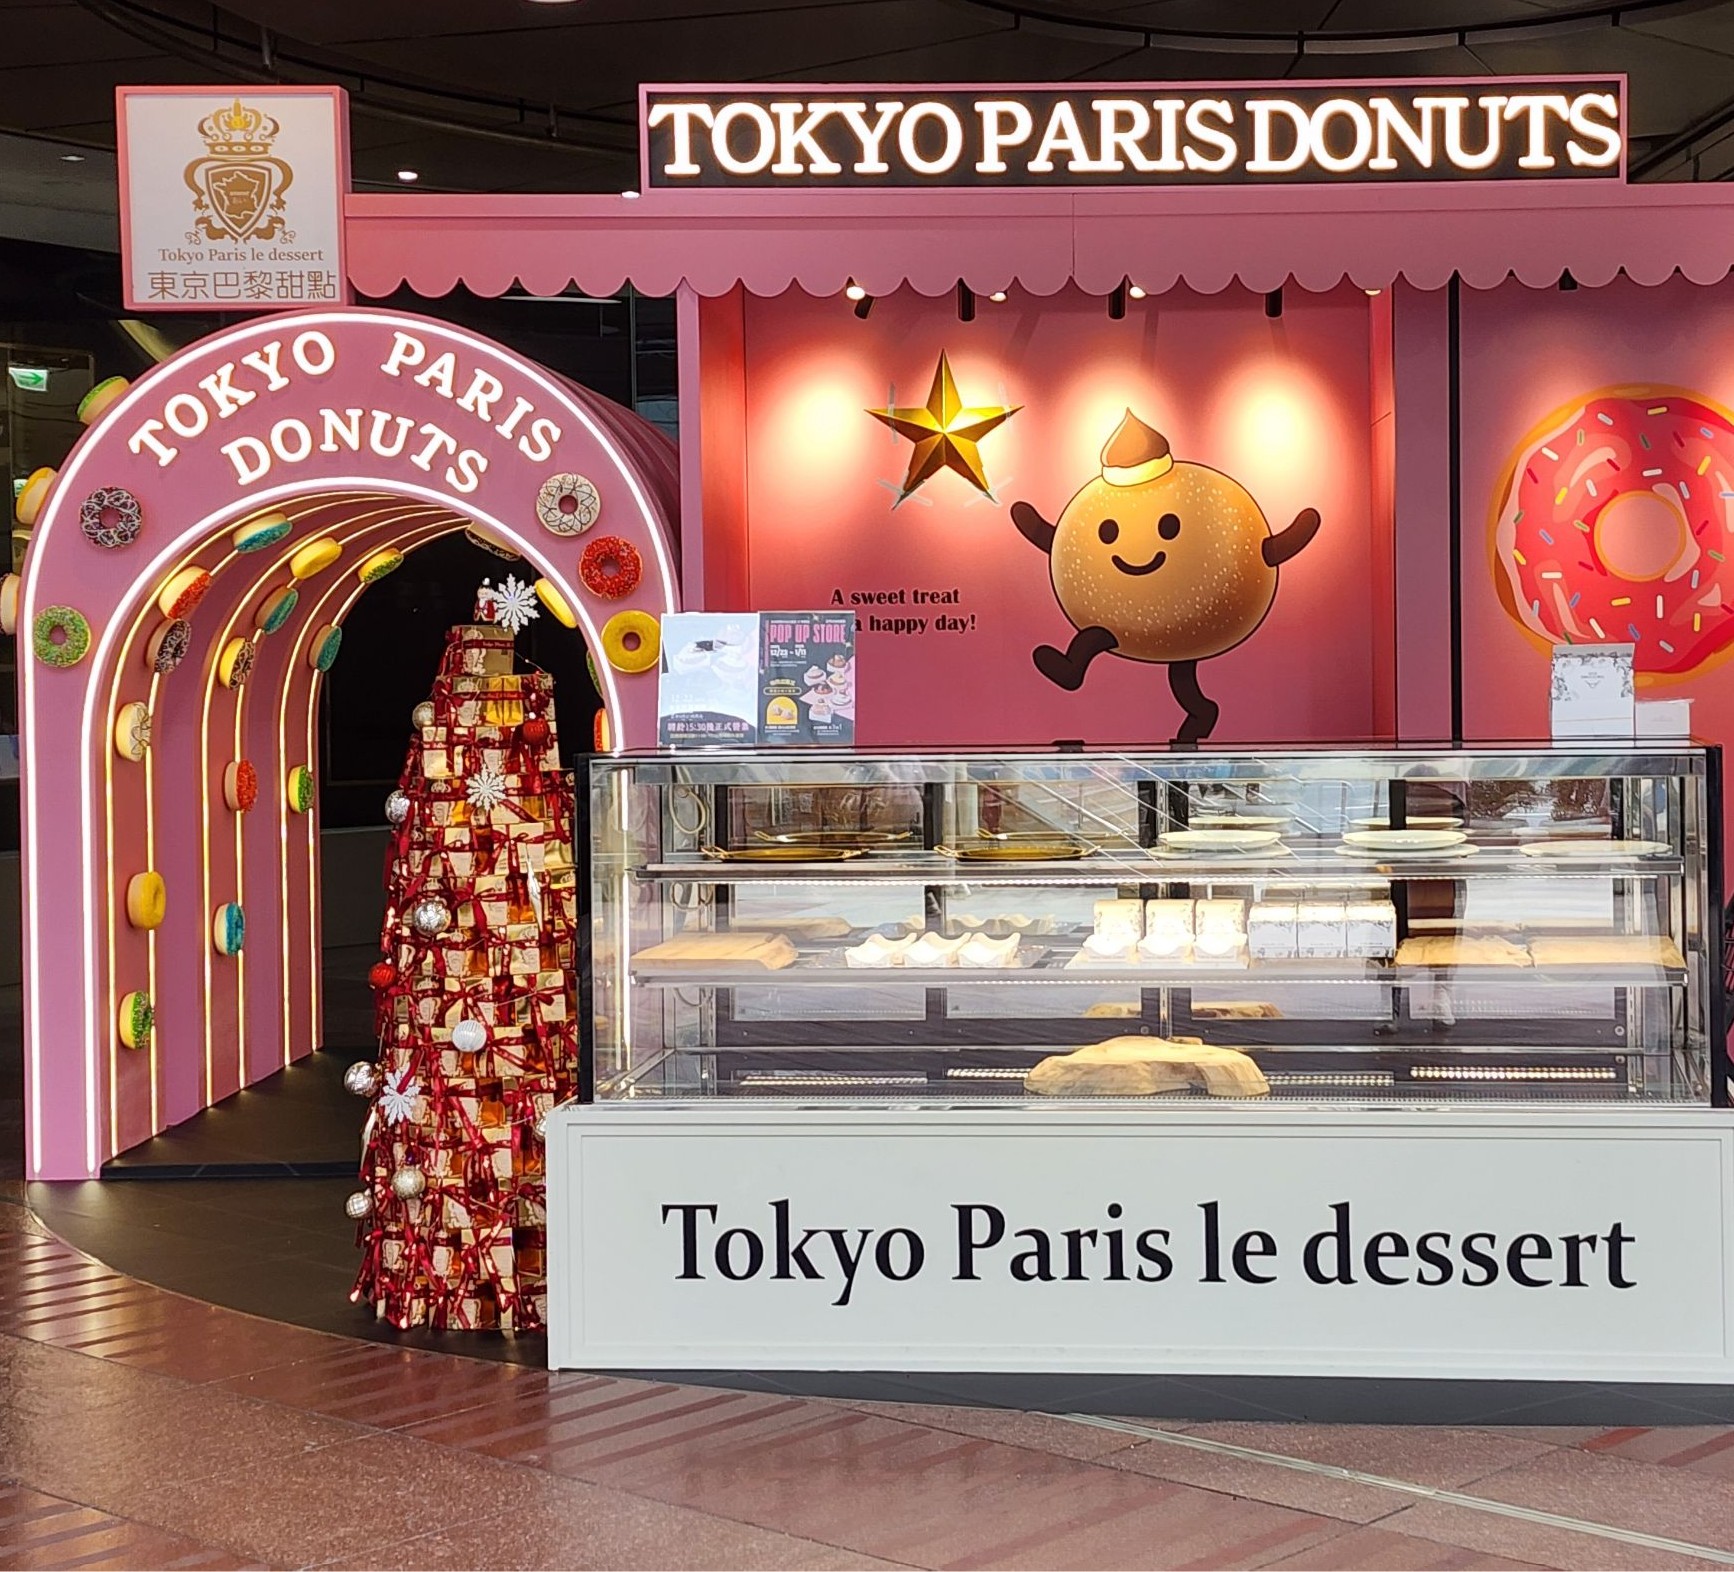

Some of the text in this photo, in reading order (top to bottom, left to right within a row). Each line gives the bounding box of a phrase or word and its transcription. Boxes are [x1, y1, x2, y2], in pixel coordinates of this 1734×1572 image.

[648, 92, 1622, 178] TOKYO PARIS DONUTS
[158, 248, 324, 265] Tokyo Paris le dessert
[148, 270, 337, 300] 東京巴黎甜點
[128, 330, 562, 467] TOKYO PARIS
[221, 408, 489, 494] DONUTS
[832, 589, 960, 605] A sweet treat
[770, 623, 846, 643] POP UP STORE
[869, 615, 928, 634] happy
[935, 614, 976, 634] day!
[662, 1199, 1637, 1306] Tokyo Paris le dessert
